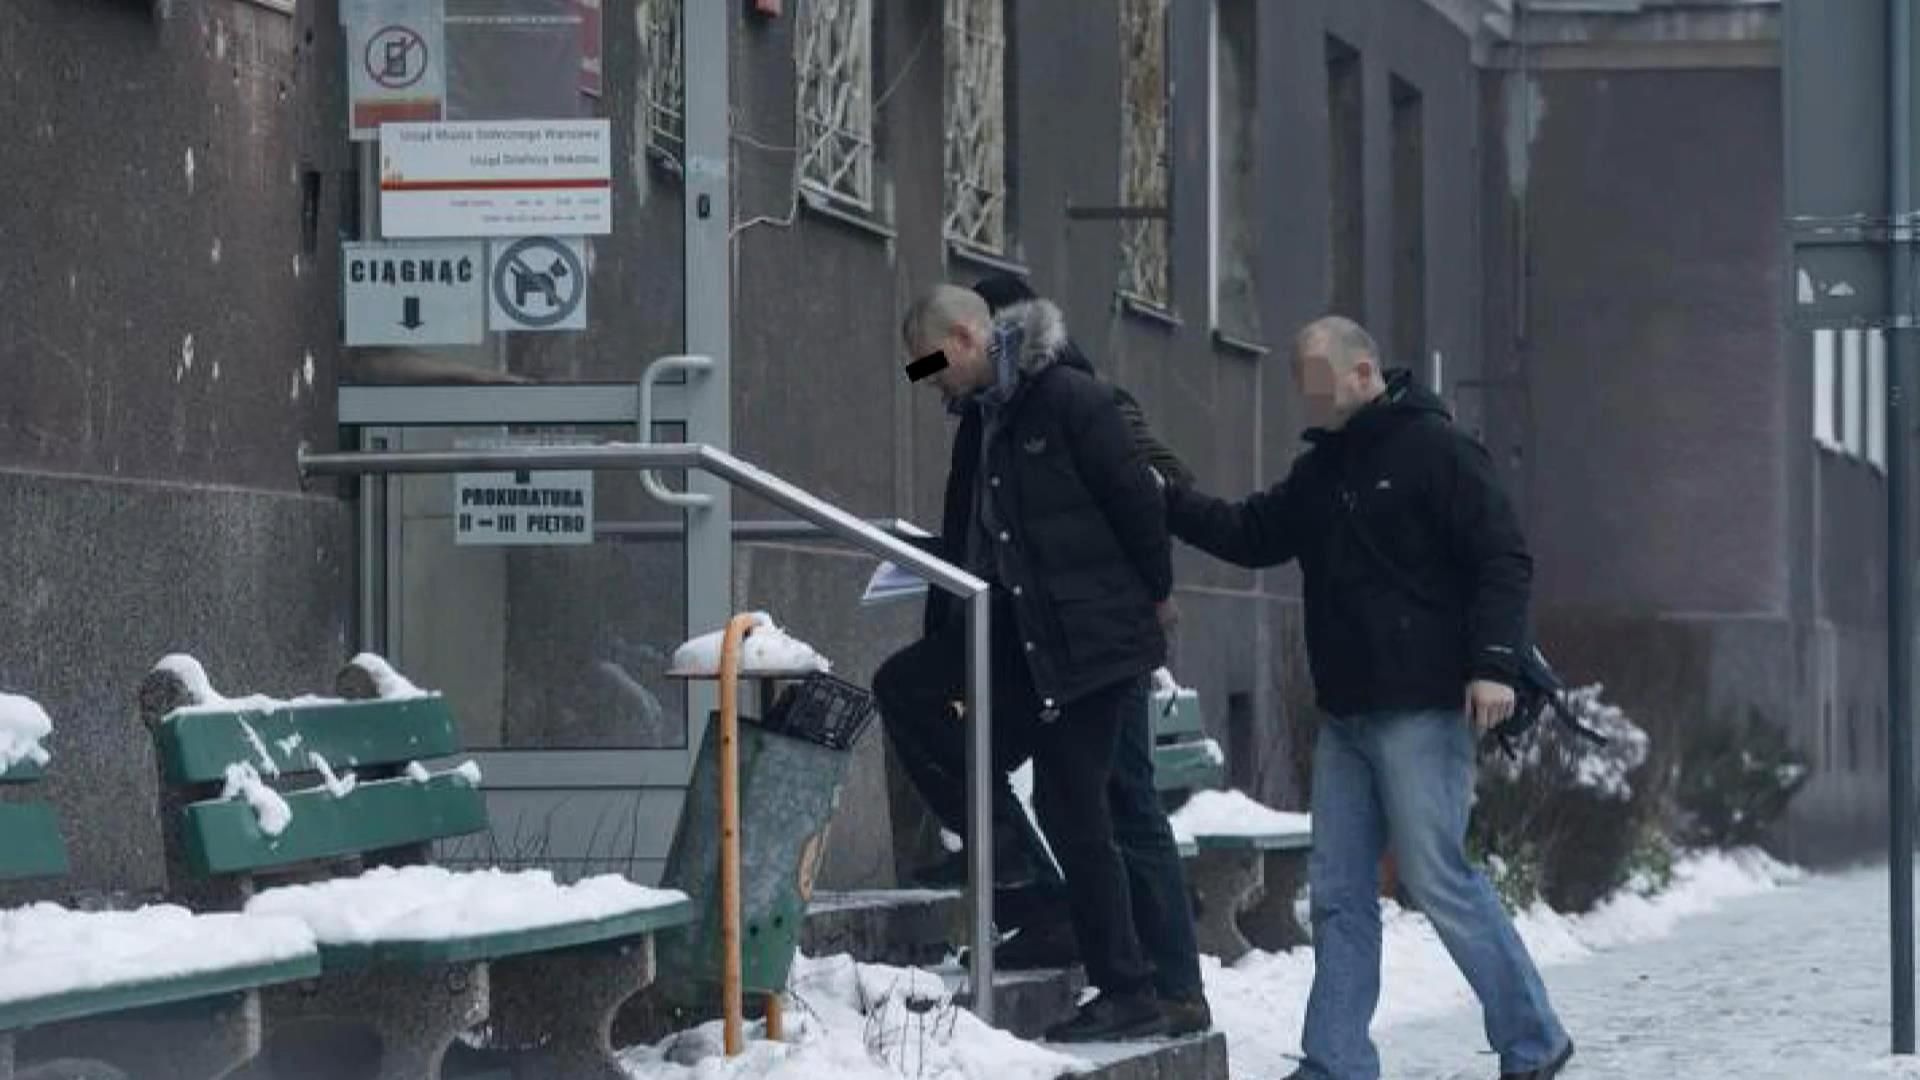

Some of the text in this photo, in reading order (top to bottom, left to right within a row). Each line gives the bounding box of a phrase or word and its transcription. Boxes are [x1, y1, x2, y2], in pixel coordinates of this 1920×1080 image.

[351, 255, 472, 286] CIĄGNĄĆ
[462, 487, 585, 507] PROKURATURA
[527, 514, 585, 534] PIĘTRO
